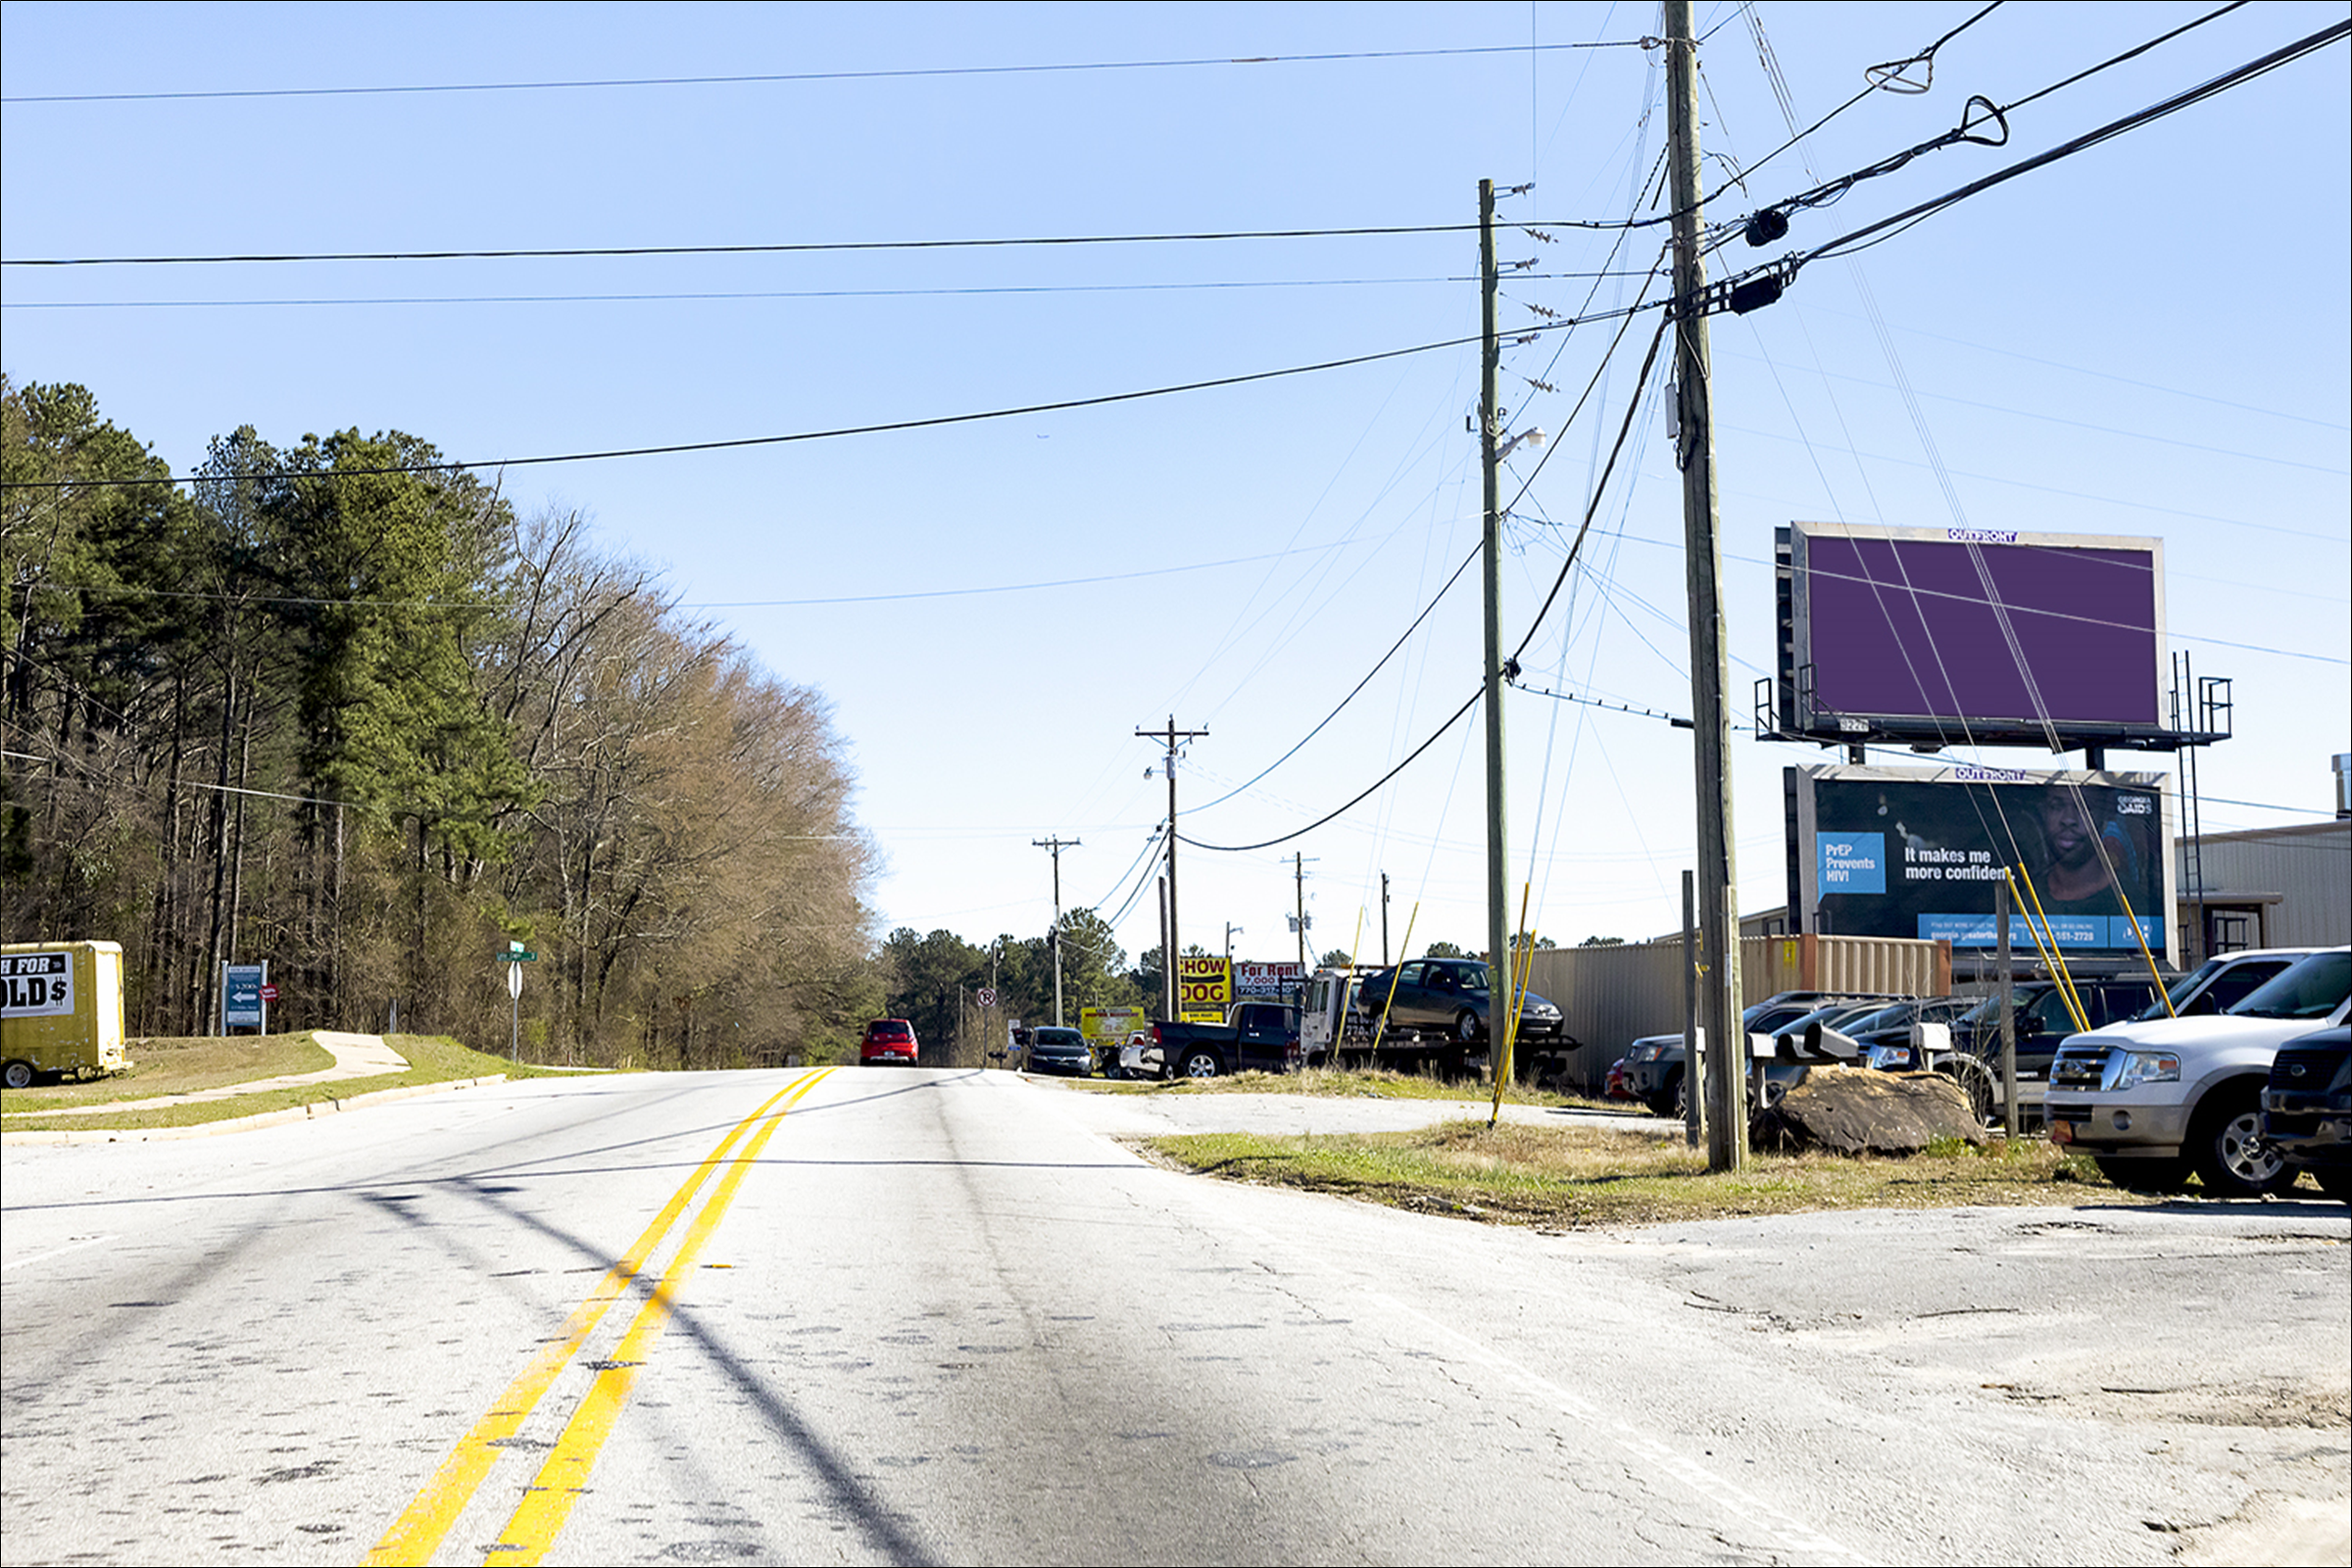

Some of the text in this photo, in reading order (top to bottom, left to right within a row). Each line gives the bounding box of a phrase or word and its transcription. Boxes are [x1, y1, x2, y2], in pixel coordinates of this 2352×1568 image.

[1949, 528, 2018, 543] OUTFRONT
[1957, 767, 2026, 782] OUTFRONT
[1826, 844, 1852, 856] PrEP
[1905, 847, 1991, 863] It makes me
[1826, 858, 1876, 869] Prevents
[1826, 870, 1849, 882] HIV!
[1905, 864, 2016, 880] more confiden.
[16, 957, 50, 974] FOR
[1241, 963, 1298, 976] For Rent
